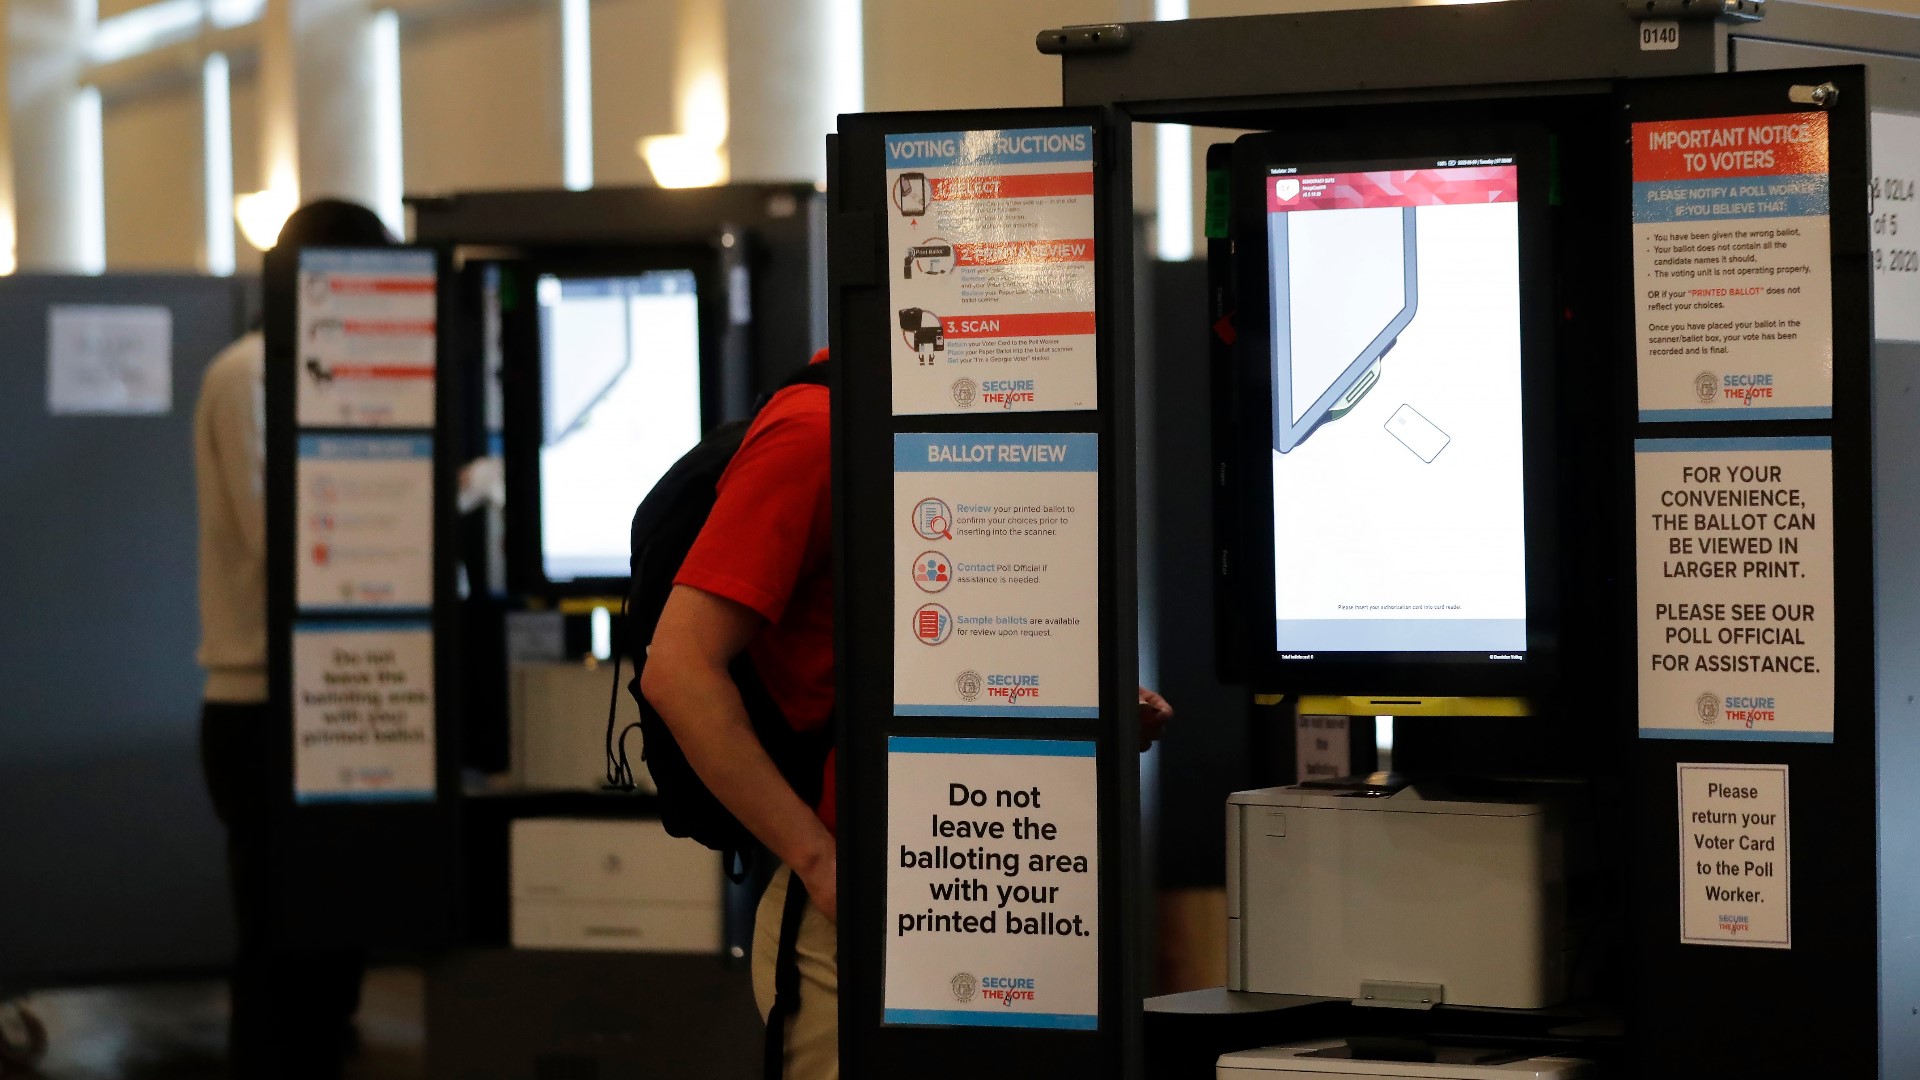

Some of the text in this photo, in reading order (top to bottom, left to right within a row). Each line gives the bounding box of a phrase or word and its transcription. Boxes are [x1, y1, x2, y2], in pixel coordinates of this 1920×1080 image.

[1643, 28, 1676, 43] 0140
[1649, 124, 1810, 150] IMPORTANT NOTICE
[890, 134, 1086, 159] VOTING INTRUCTIONS
[1683, 150, 1775, 172] TO VOTERS
[1648, 188, 1687, 201] PLEASE
[1689, 186, 1726, 200] NOTIFY
[1730, 187, 1737, 197] A
[1739, 185, 1766, 196] POLL
[1684, 205, 1710, 215] YOU
[1713, 203, 1755, 214] BELIEVE
[1758, 201, 1787, 212] THAT:
[1889, 214, 1898, 235] 5
[1690, 232, 1709, 240] been
[1712, 230, 1733, 240] given
[1735, 230, 1747, 238] the
[1750, 230, 1774, 239] wrong
[1654, 246, 1671, 254] Your
[1673, 244, 1695, 252] ballot
[1732, 242, 1761, 250] contain
[1654, 257, 1692, 265] candidate
[1694, 256, 1719, 264] names
[1890, 250, 1919, 272] 2020
[1654, 270, 1669, 278] The
[1671, 269, 1695, 278] voting
[1697, 268, 1712, 276] unit
[1737, 266, 1774, 276] operating
[1648, 290, 1659, 298] OR
[1662, 290, 1666, 298] if
[1669, 290, 1685, 300] your
[1766, 286, 1785, 294] does
[1648, 301, 1725, 312] reflect your choices.
[947, 320, 1000, 332] 3. SCAN
[1649, 323, 1669, 331] Once
[1671, 324, 1685, 332] you
[1687, 322, 1705, 330] have
[1708, 322, 1733, 330] placed
[1735, 322, 1752, 330] your
[1649, 335, 1703, 344] scanner/ballot
[1723, 334, 1740, 343] your
[1777, 332, 1797, 340] been
[1649, 347, 1683, 355] recorded
[1686, 347, 1700, 355] and
[1710, 346, 1729, 354] final.
[927, 444, 1068, 463] BALLOT REVIEW
[1682, 465, 1782, 483] FOR YOUR
[1661, 489, 1806, 509] CONVENIENCE,
[957, 504, 991, 513] Review
[994, 506, 1011, 515] your
[1013, 505, 1041, 515] printed
[1043, 505, 1065, 513] ballot
[957, 516, 1068, 527] confirm your choices prior to
[1652, 513, 1816, 531] THE BALLOT CAN
[957, 528, 990, 537] inserting
[992, 528, 1007, 536] into
[1009, 528, 1022, 536] the
[1669, 537, 1798, 554] BE VIEWED IN
[957, 563, 1048, 572] Contact Poll Official if
[1663, 561, 1806, 578] LARGER PRINT.
[1008, 576, 1040, 584] needed.
[957, 615, 993, 625] Sample
[995, 616, 1028, 624] ballots
[1045, 617, 1080, 625] available
[1655, 603, 1815, 621] PLEASE SEE OUR
[957, 628, 967, 636] for
[998, 630, 1018, 638] upon
[1666, 627, 1806, 645] POLL OFFICIAL
[1652, 654, 1820, 674] FOR ASSISTANCE.
[949, 783, 1041, 808] Do not
[1708, 783, 1758, 799] Please
[932, 814, 1057, 840] leave the
[1692, 810, 1776, 828] return your
[1694, 834, 1775, 851] Voter Card
[900, 845, 1088, 877] balloting area
[1697, 861, 1773, 876] to the Poll
[930, 878, 1059, 909] with your
[1705, 886, 1764, 903] Worker.
[898, 909, 1090, 937] printed ballot.
